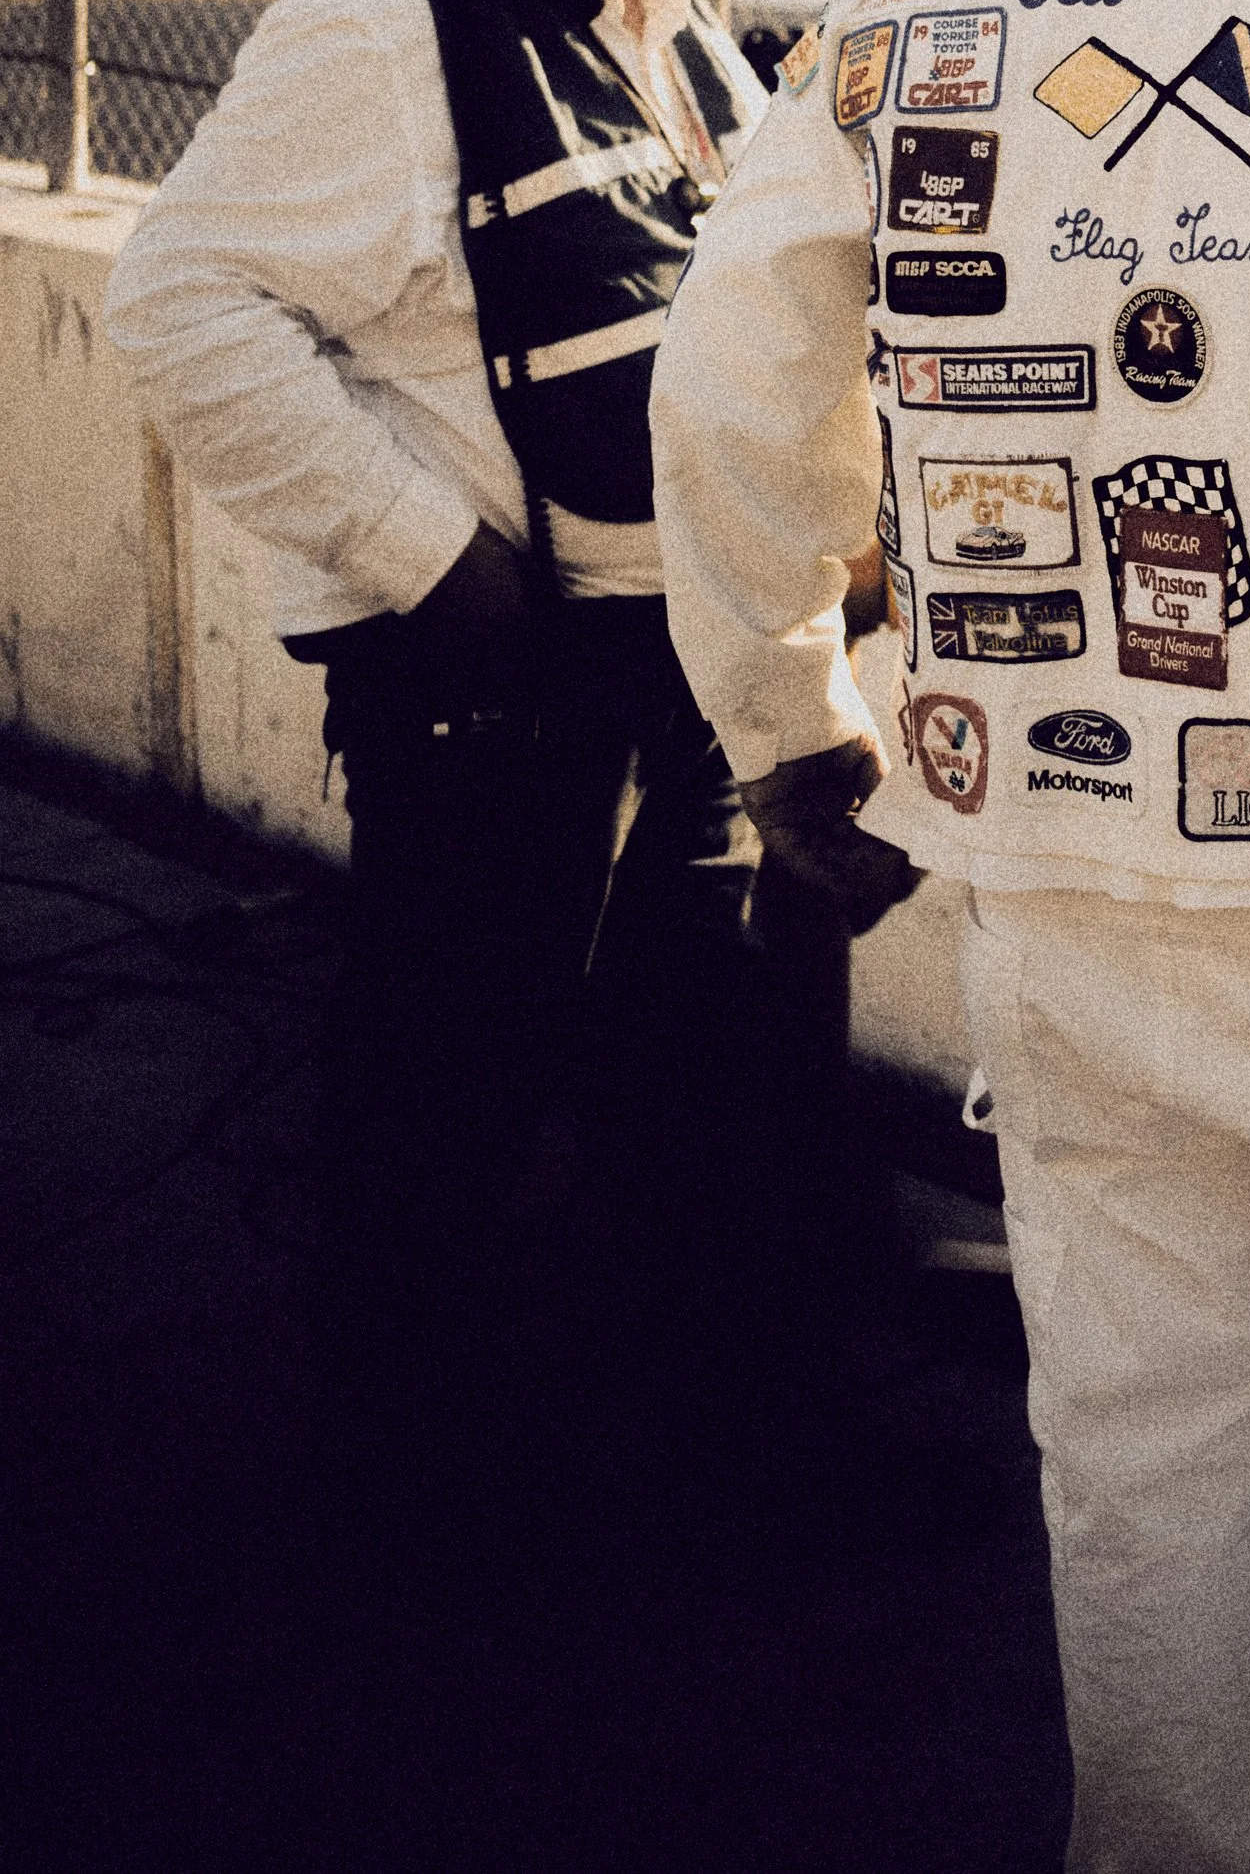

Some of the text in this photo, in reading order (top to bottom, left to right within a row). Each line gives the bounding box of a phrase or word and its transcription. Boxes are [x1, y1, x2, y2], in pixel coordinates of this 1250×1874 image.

[913, 21, 999, 40] 19 84
[934, 18, 979, 29] COURSE
[932, 30, 979, 41] WORKER
[933, 43, 977, 53] TOYOTA
[908, 81, 988, 106] CART
[901, 138, 917, 154] 19
[899, 199, 979, 226] CART
[1050, 207, 1144, 286] Flag
[935, 260, 996, 277] SCCA
[1114, 290, 1206, 370] 1983 INDIANAPOLIS 500 WINNER
[943, 362, 1079, 381] SEARS POINT
[1126, 366, 1197, 388] Racing Team
[946, 381, 1077, 395] INTERNATIONAL RACEWAY
[928, 474, 1067, 512] CAMEL
[1142, 531, 1200, 555] NASCAR
[1134, 565, 1207, 598] Winston
[962, 603, 1078, 625] Team Lotus
[1152, 594, 1189, 628] Cup
[970, 630, 1068, 653] Valvoline
[1127, 631, 1213, 659] Grand National
[1150, 652, 1189, 672] Drivers
[1054, 716, 1114, 754] Ford
[1028, 769, 1133, 803] Motorsport
